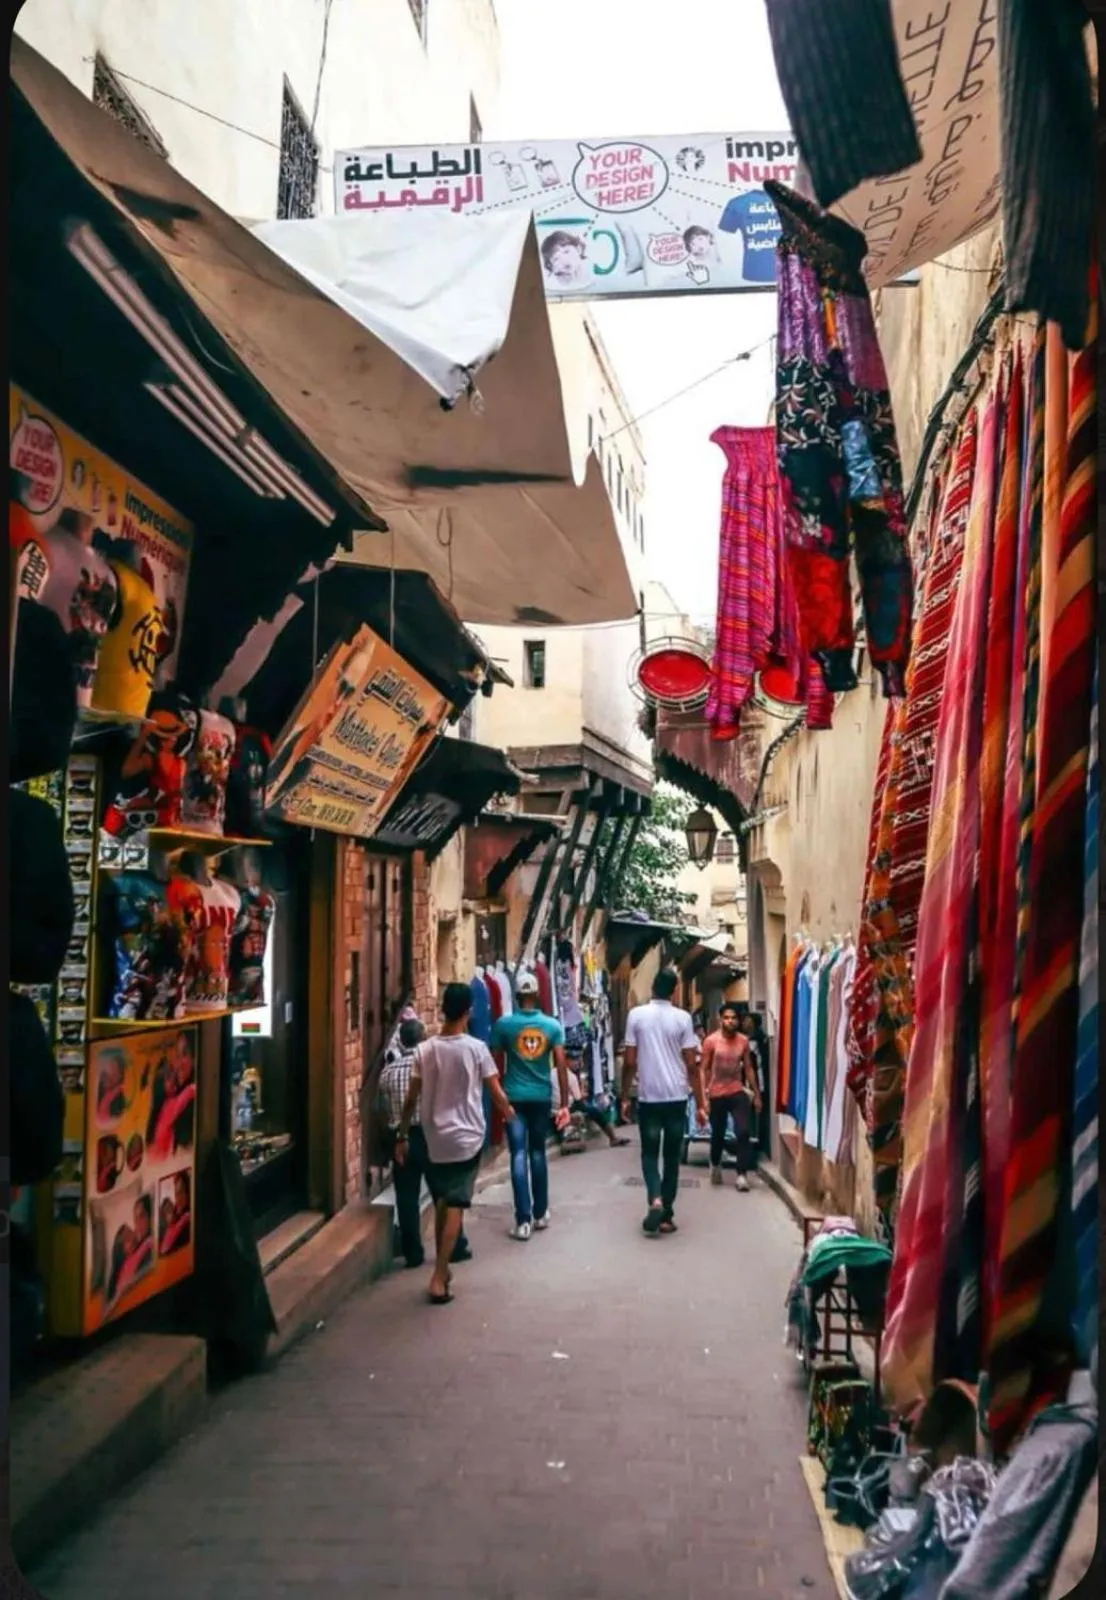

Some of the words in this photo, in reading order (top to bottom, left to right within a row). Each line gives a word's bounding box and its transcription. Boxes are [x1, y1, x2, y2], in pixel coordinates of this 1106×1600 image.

[344, 148, 482, 184] الطباعة
[590, 147, 642, 170] YOUR
[585, 164, 654, 190] DESIGN
[344, 176, 483, 213] الرقمية
[595, 182, 654, 207] HERE!
